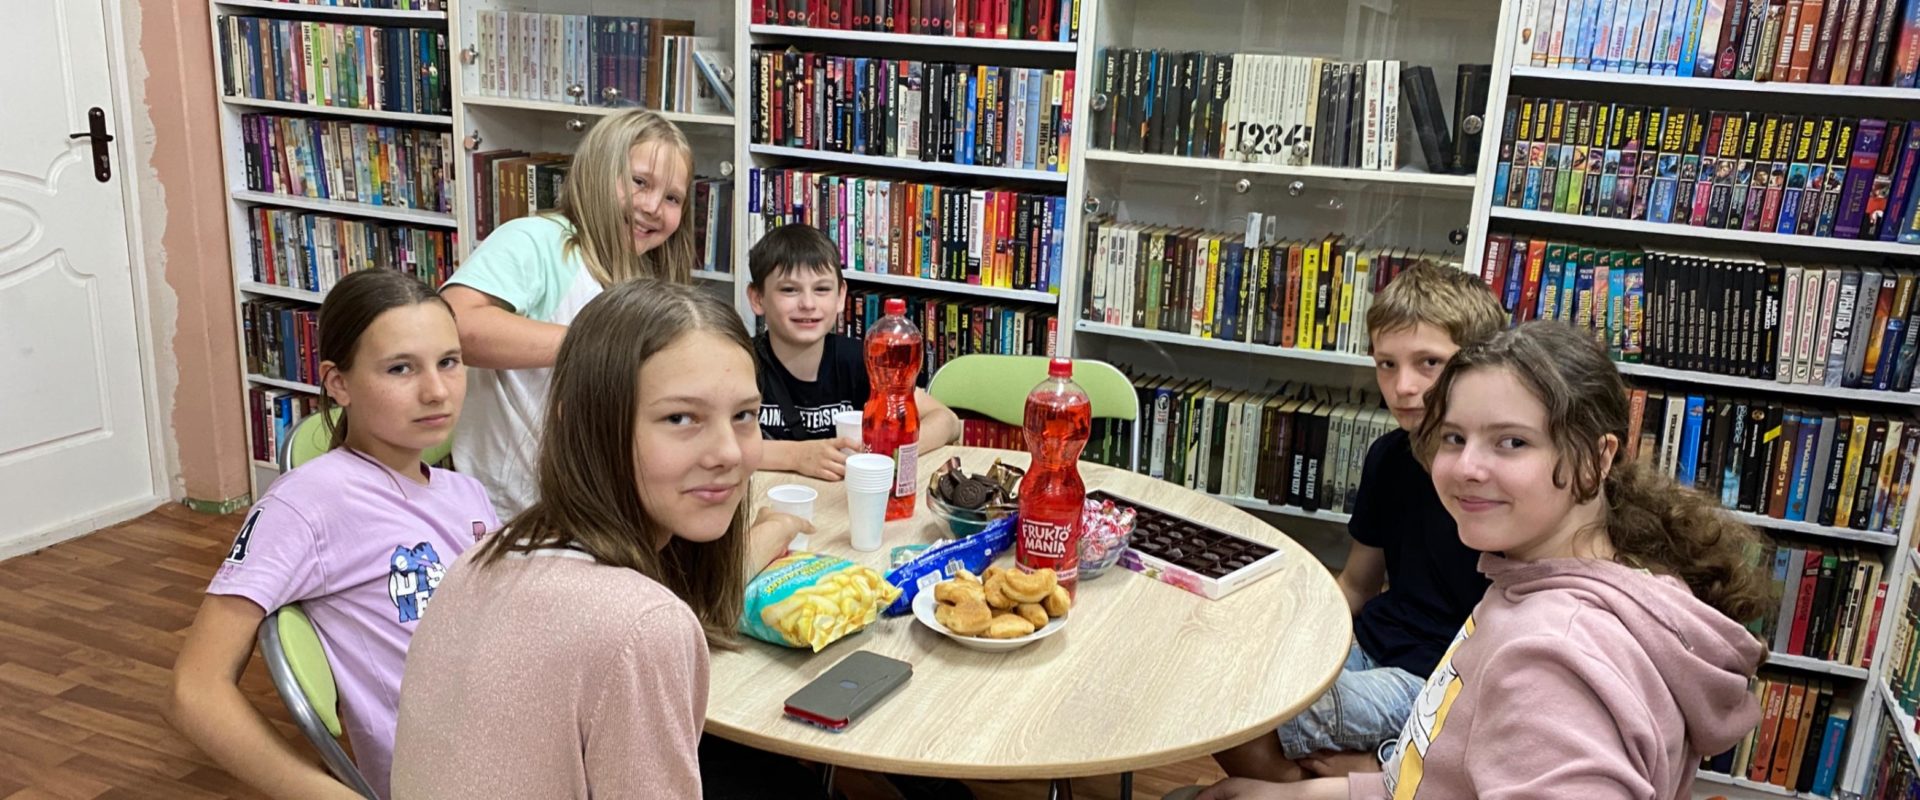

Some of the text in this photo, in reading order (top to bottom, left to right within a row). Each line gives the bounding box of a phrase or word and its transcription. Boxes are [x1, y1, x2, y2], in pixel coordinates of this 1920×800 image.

[1040, 123, 1048, 145] ЧИЖ
[1865, 287, 1876, 319] ДИЛЕР
[758, 408, 785, 426] AIN
[1797, 478, 1806, 499] ОЛЬГА
[226, 507, 264, 564] A
[1022, 524, 1070, 542] FRUKTO
[1025, 538, 1066, 553] MANIA
